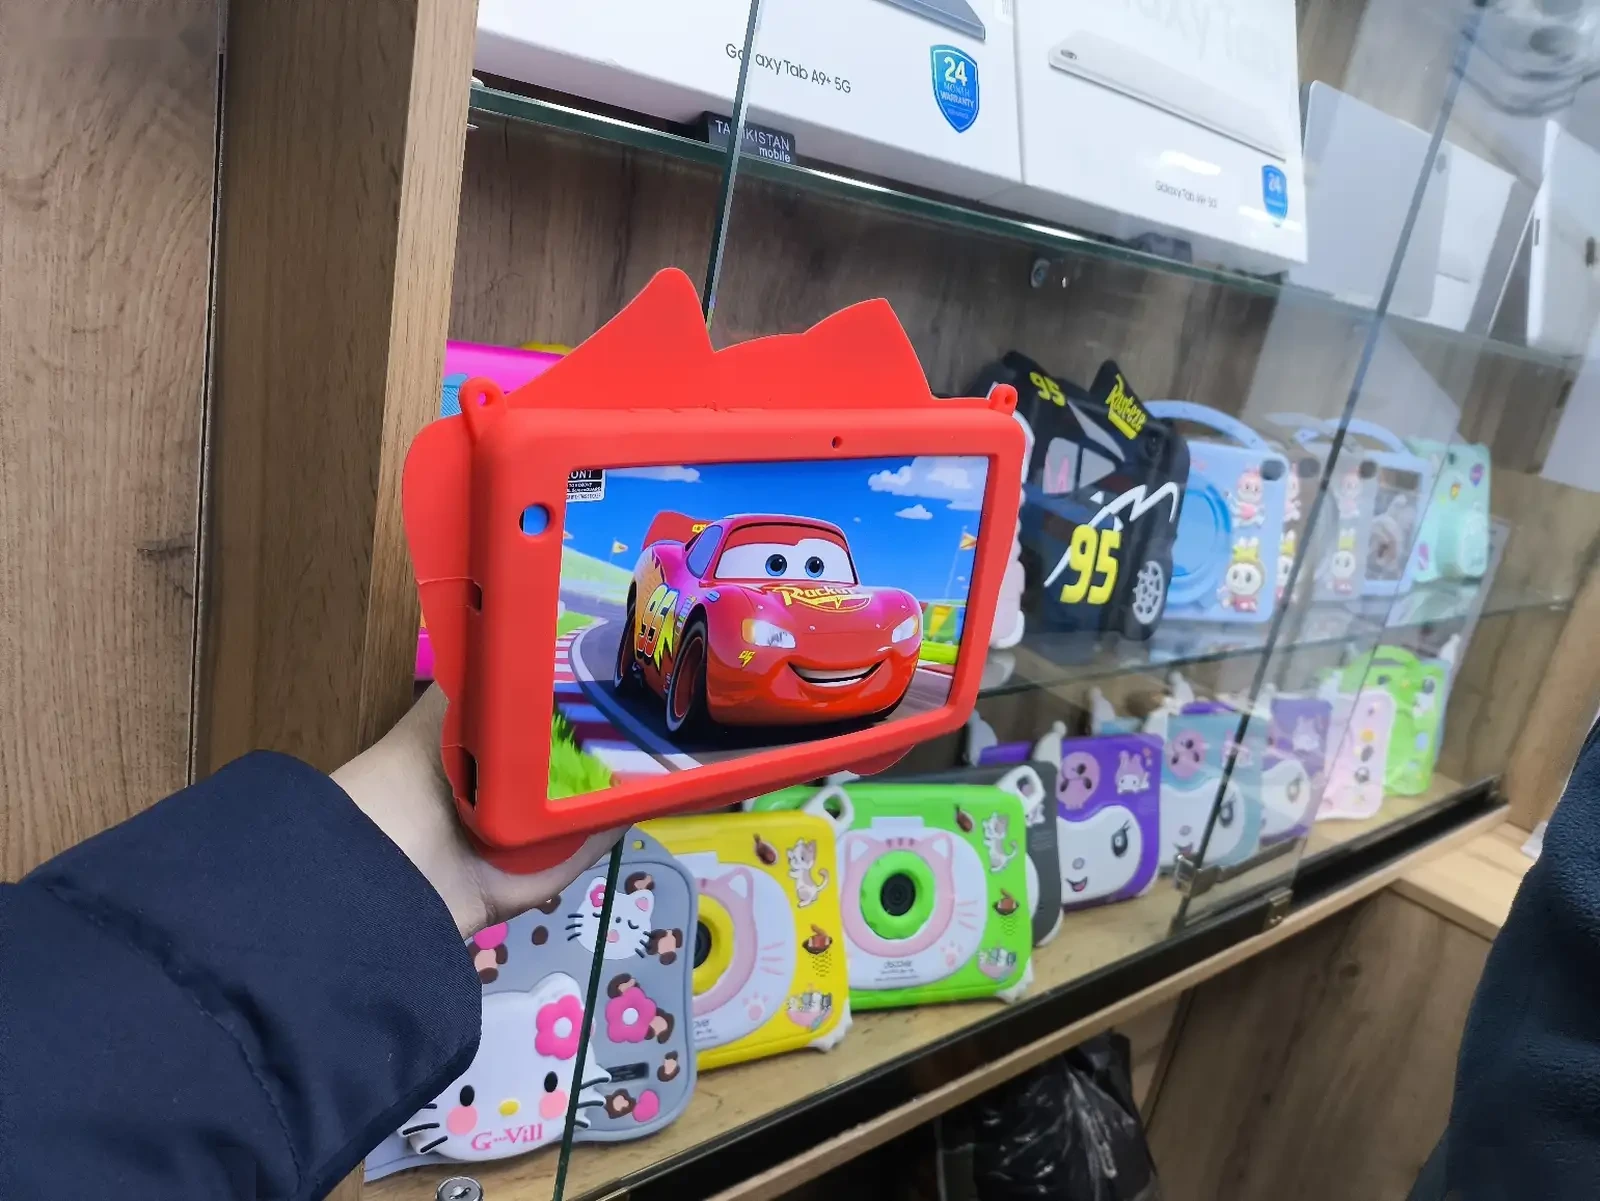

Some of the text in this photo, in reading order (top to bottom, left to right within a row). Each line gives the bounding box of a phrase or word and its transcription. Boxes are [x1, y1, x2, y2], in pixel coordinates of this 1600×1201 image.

[725, 43, 852, 94] Gaaxy Tab A9+ 5G
[943, 56, 968, 87] 24
[939, 89, 975, 109] WARRANTY
[943, 81, 970, 98] MONTH
[714, 119, 790, 152] TAIKISTAN
[759, 146, 791, 163] mobile
[1029, 371, 1066, 407] 95
[1060, 524, 1122, 605] 95
